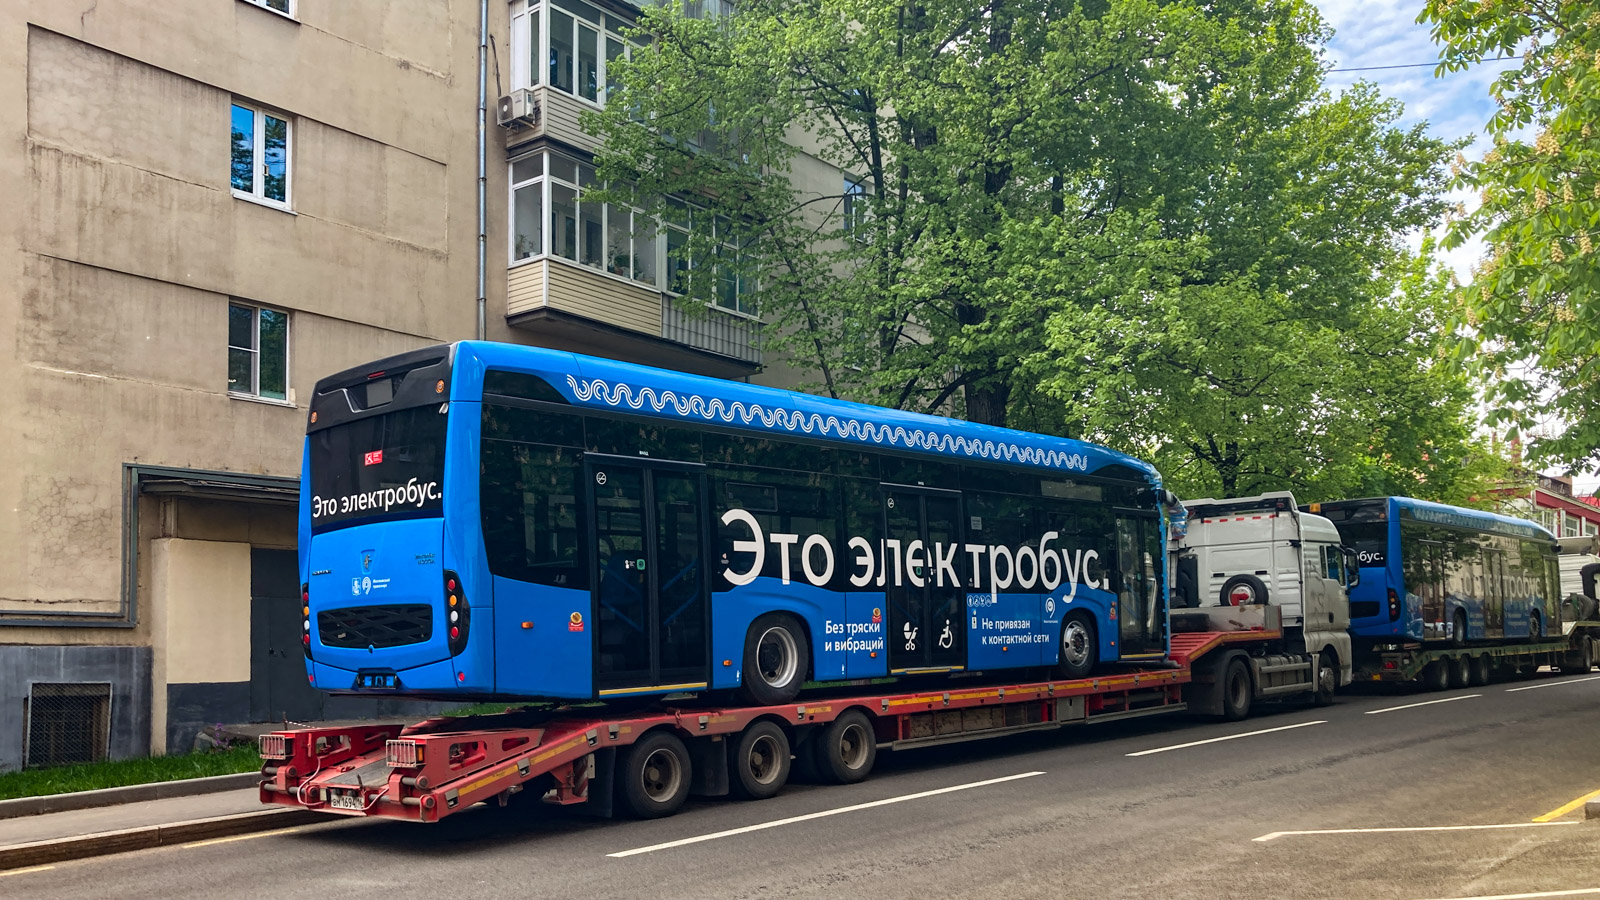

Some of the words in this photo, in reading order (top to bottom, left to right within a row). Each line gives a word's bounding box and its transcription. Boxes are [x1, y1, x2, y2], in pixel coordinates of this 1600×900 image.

[312, 495, 338, 518] Это
[340, 477, 442, 512] электробус.
[720, 508, 835, 586] Это
[847, 531, 1110, 604] электробус.
[825, 620, 845, 635] Без
[846, 622, 881, 637] тряски
[981, 617, 994, 630] Не
[995, 619, 1031, 632] привязан
[824, 641, 833, 652] и
[834, 636, 884, 654] вибраций
[981, 635, 988, 645] к
[988, 632, 1032, 645] контактной
[1033, 633, 1050, 643] сети
